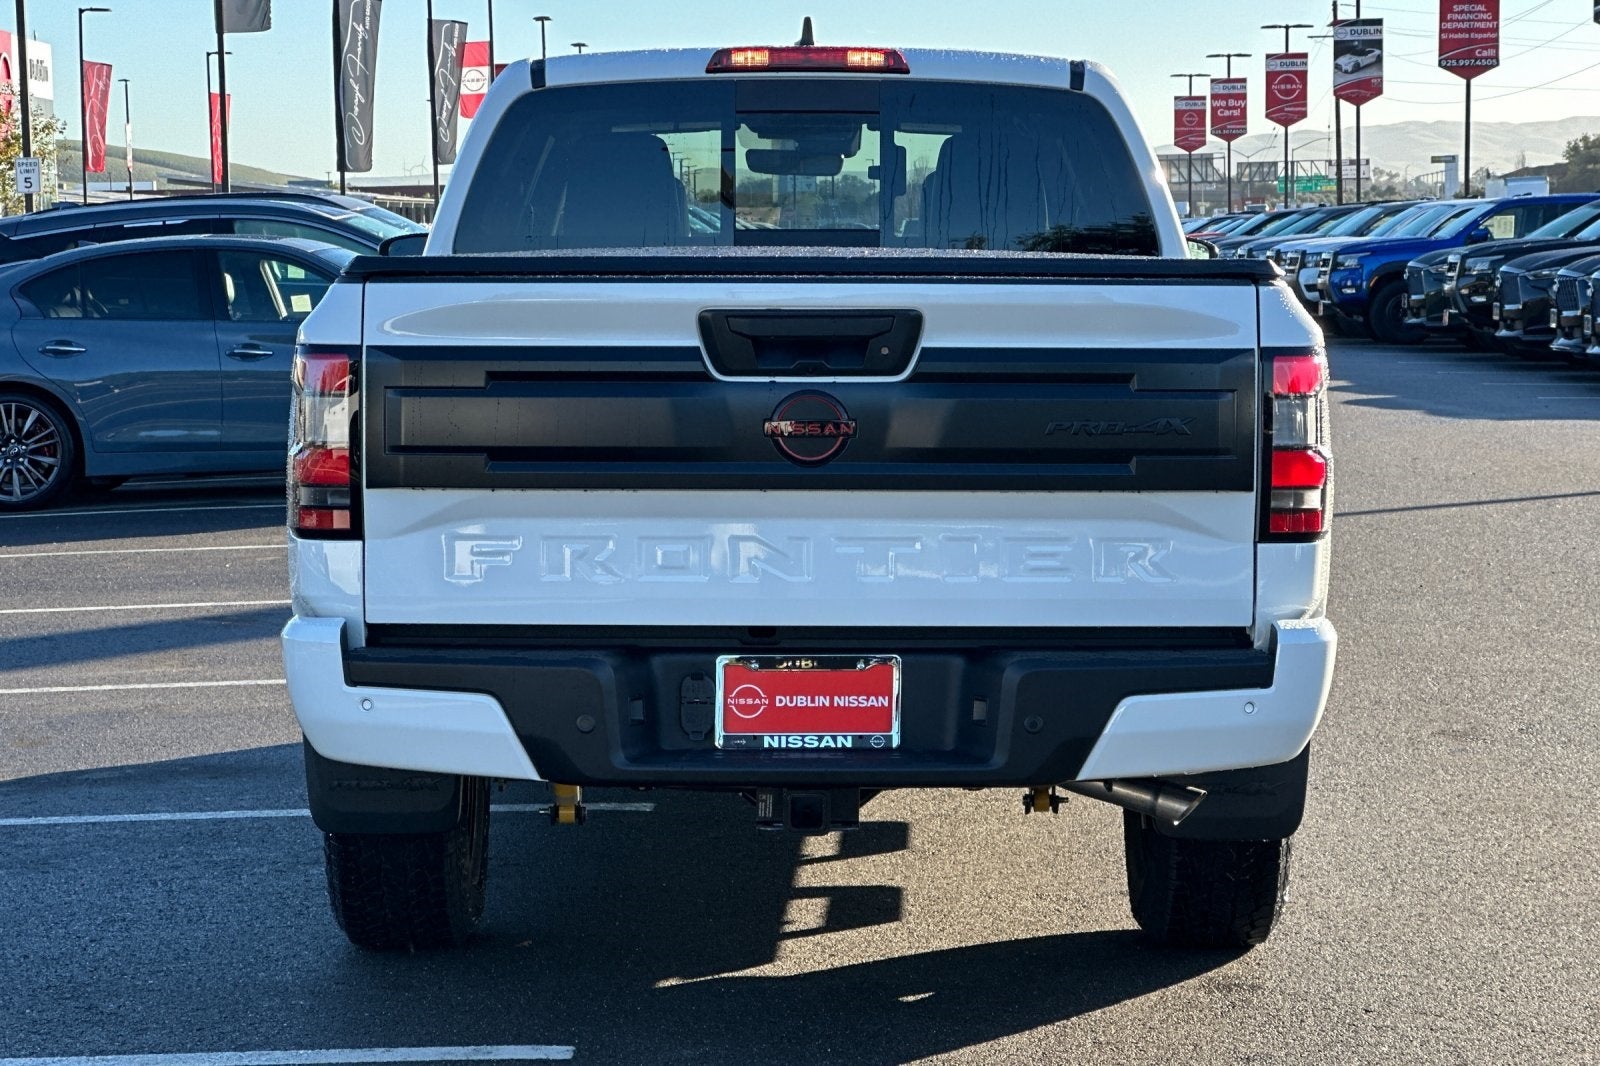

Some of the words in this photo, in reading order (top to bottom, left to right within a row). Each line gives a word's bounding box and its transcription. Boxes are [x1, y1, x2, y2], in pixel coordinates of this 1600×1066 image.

[1441, 21, 1498, 29] DEPARTMENT
[1349, 28, 1382, 36] DUBLIN
[1475, 48, 1496, 57] Call!
[1211, 99, 1227, 107] We
[1228, 98, 1246, 108] Buy
[1217, 108, 1241, 117] Cars!
[24, 176, 33, 189] 5
[764, 420, 855, 436] NISSAN
[441, 531, 1180, 585] FRONTIER
[775, 695, 830, 707] DUBLIN
[833, 695, 889, 707] NISSAN
[763, 735, 853, 748] NISSAN
